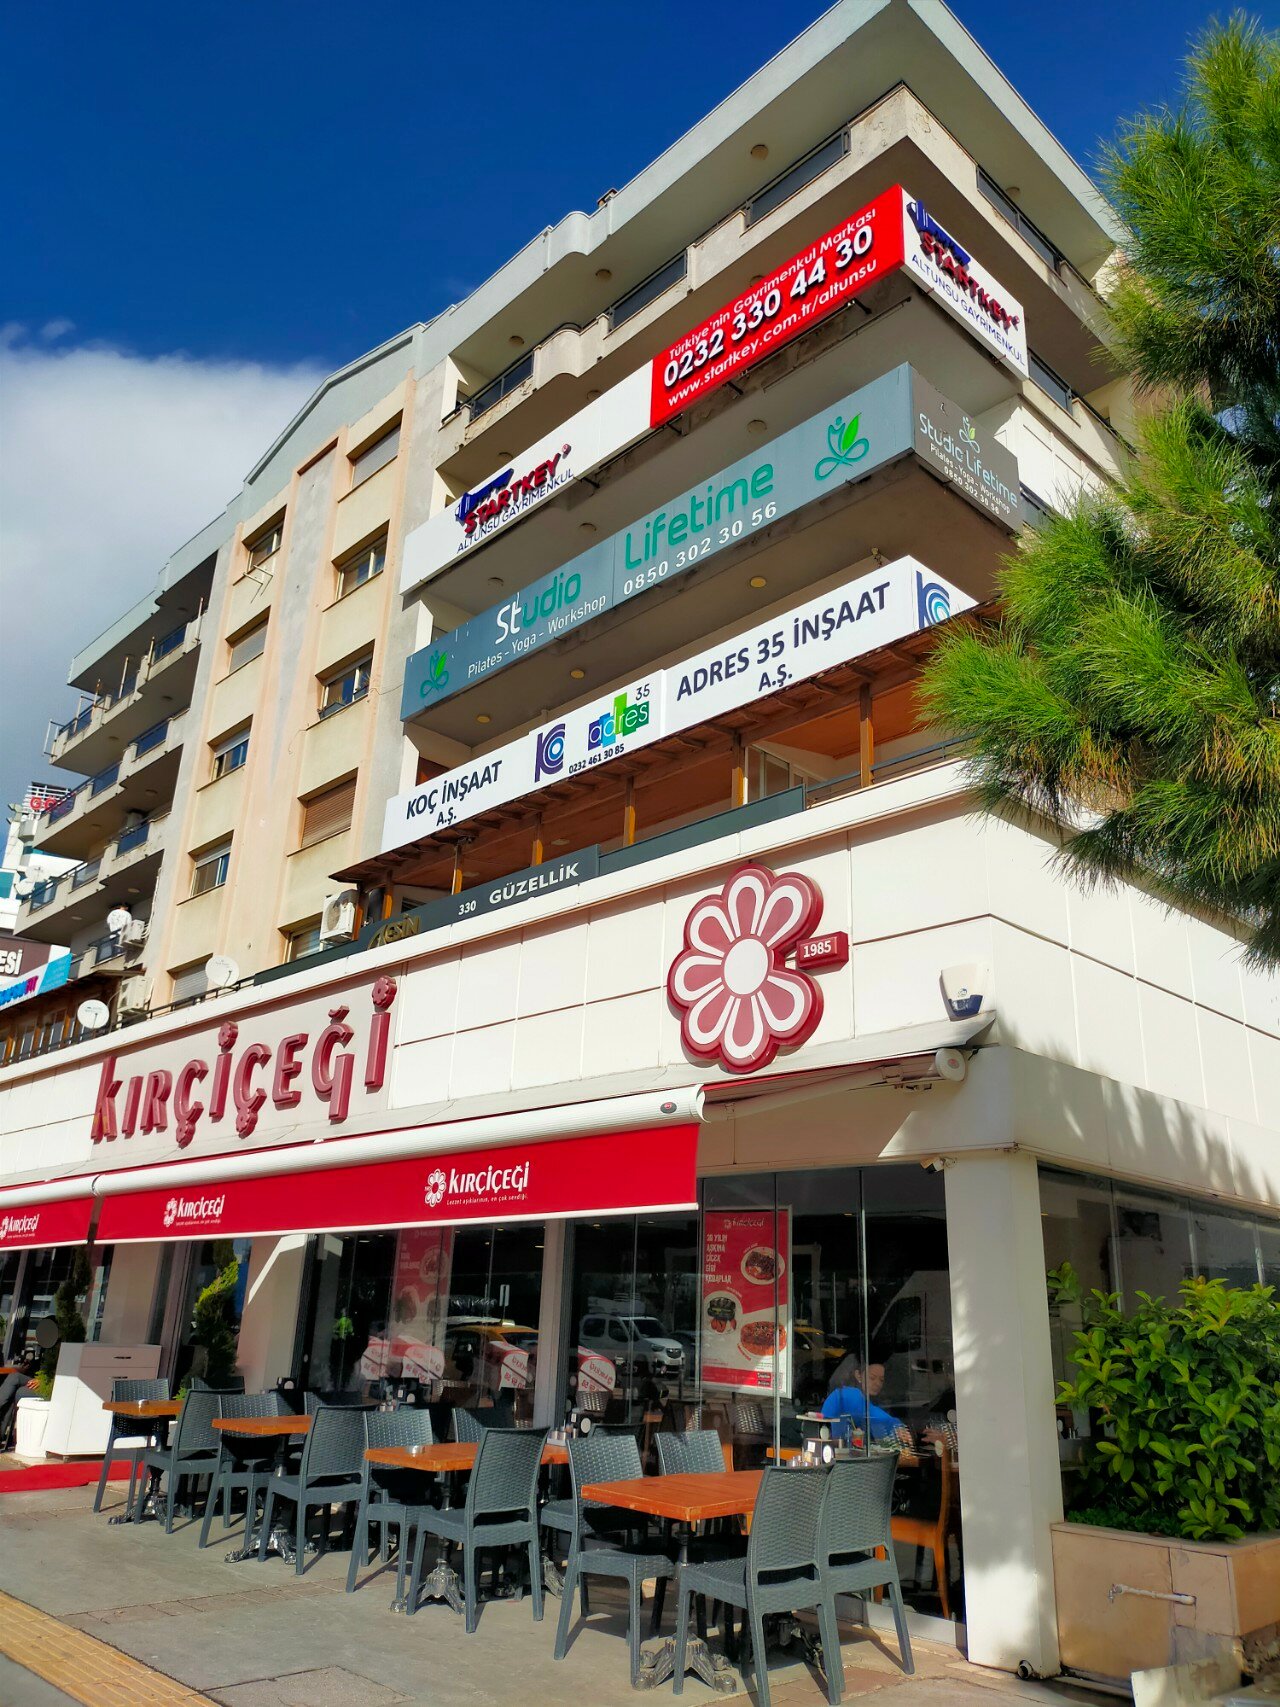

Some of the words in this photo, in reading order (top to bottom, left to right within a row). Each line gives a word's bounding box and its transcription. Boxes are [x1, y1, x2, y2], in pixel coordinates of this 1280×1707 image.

[664, 328, 724, 388] 0232
[731, 289, 781, 341] 330
[790, 256, 826, 298] 44
[835, 225, 873, 268] 30
[669, 311, 730, 360] Türkiye'nin
[733, 248, 816, 313] Gayrimenkul
[819, 209, 876, 254] Markası
[912, 254, 959, 303] ALTUNSU
[960, 299, 1025, 366] GAYRİMENKUL
[668, 259, 877, 406] www.startkey.com.tr/altunsu
[919, 413, 964, 463] Studio
[965, 449, 1018, 509] Lifetime
[930, 442, 954, 469] Pilates
[958, 465, 975, 486] Yoga
[980, 484, 1011, 515] Workshop
[943, 466, 963, 486] 0850
[964, 481, 979, 498] 302
[457, 518, 500, 554] ALTUNSU
[494, 572, 581, 645] Studio
[624, 463, 774, 570] Lifetime
[623, 560, 669, 596] 0850
[675, 537, 711, 568] 302
[718, 520, 743, 544] 30
[751, 501, 777, 527] 56
[467, 651, 503, 679] Pilates
[511, 632, 537, 656] Yoga
[547, 595, 606, 635] Workshop
[676, 647, 750, 702] ADRES
[756, 631, 785, 664] 35
[793, 581, 890, 648] İNŞAAT
[635, 683, 651, 701] 35
[758, 663, 793, 692] A.Ş.
[406, 789, 438, 820] KOÇ
[441, 760, 503, 805] İNŞAAT
[568, 761, 586, 774] 0232
[588, 753, 602, 766] 461
[603, 748, 614, 760] 30
[614, 743, 625, 755] 85
[436, 806, 457, 827] A.Ş.
[458, 900, 477, 916] 330
[489, 862, 579, 904] GÜZELLİK
[803, 940, 832, 958] 1985
